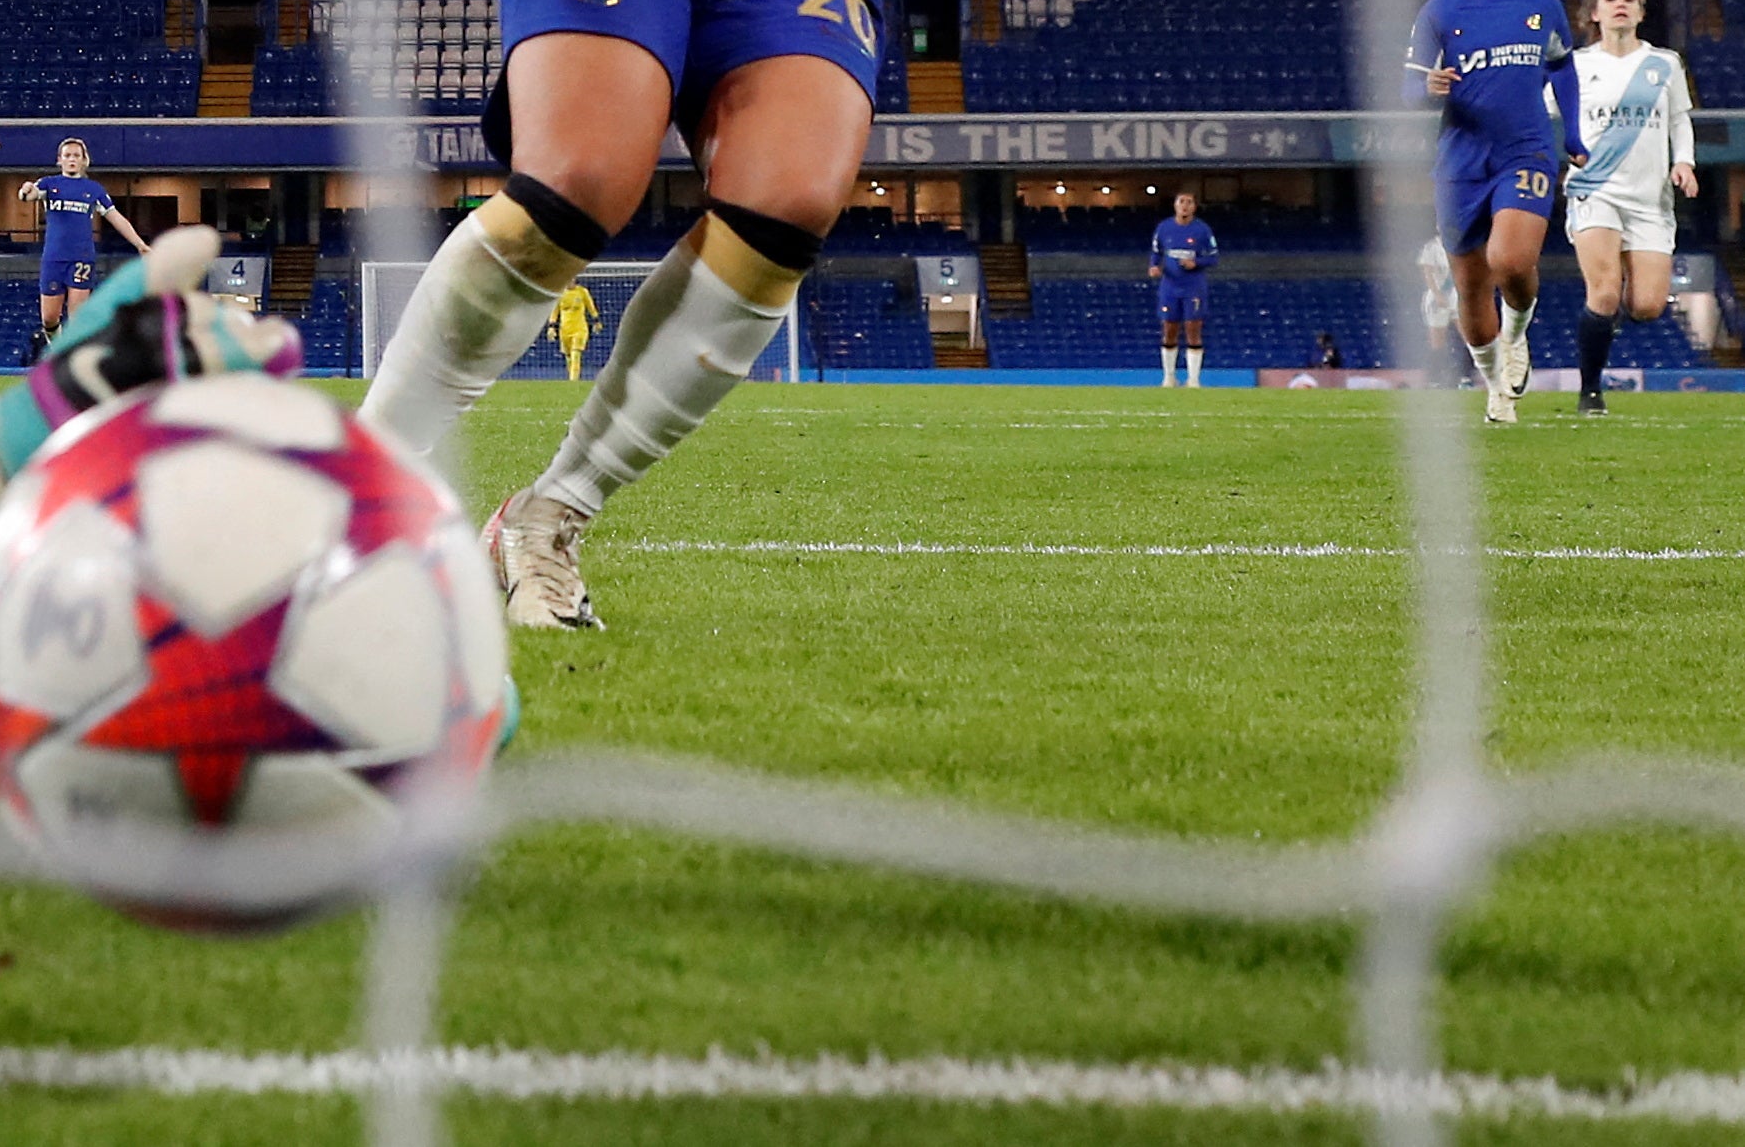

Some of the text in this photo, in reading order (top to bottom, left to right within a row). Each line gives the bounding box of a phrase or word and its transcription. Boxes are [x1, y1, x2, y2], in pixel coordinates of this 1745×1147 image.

[423, 126, 498, 163] TAM
[884, 121, 1229, 163] IS THE KING
[74, 261, 92, 281] 22
[231, 259, 245, 278] 4
[940, 258, 954, 278] 5
